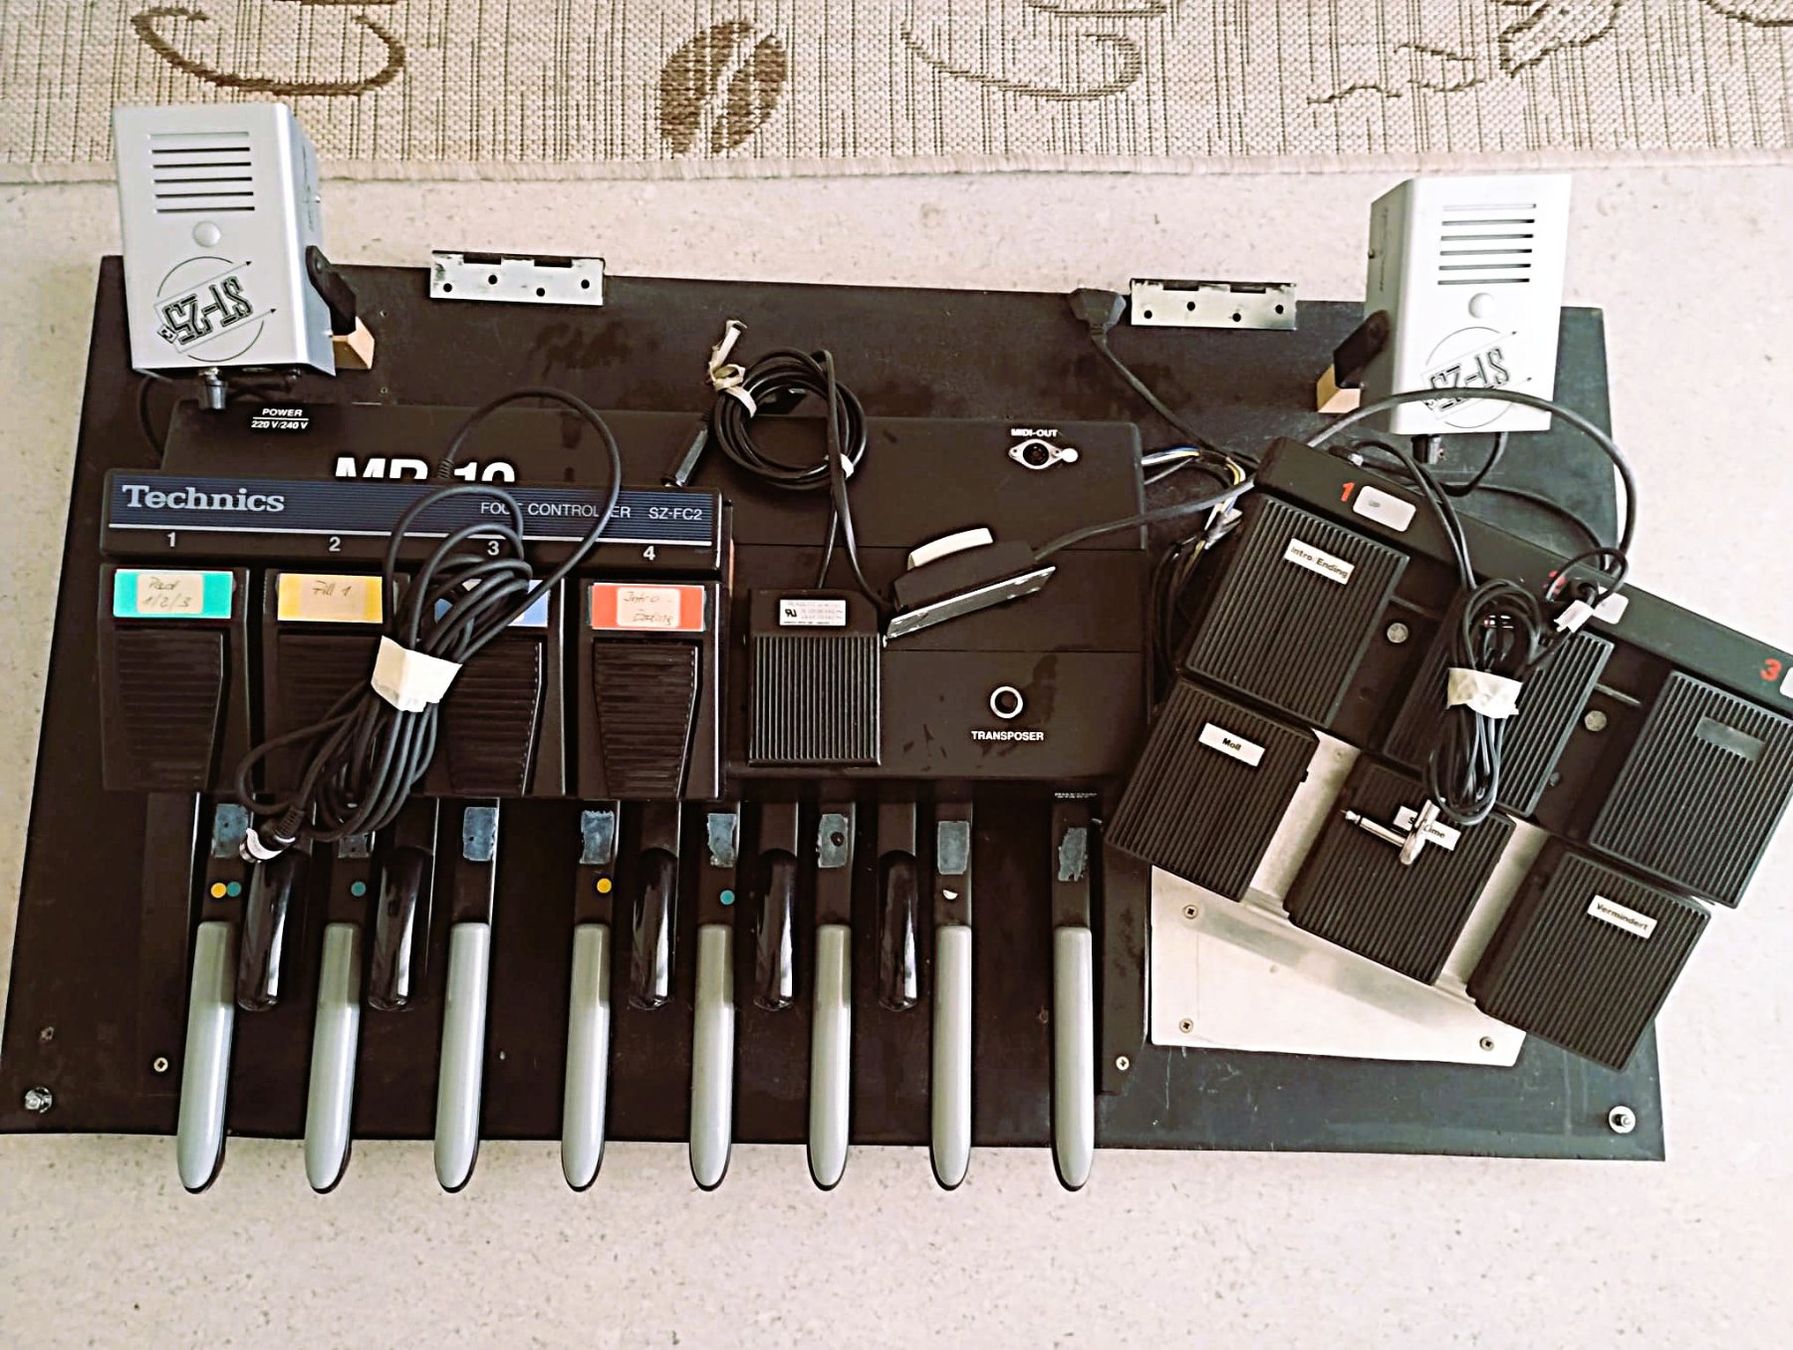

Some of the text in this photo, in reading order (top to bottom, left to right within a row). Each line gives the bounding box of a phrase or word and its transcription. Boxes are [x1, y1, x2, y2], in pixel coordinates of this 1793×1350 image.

[262, 408, 303, 417] POWER
[251, 420, 270, 429] 220
[300, 421, 309, 430] V
[1010, 428, 1058, 438] MIDI-OUT
[122, 484, 285, 513] Technics
[1340, 481, 1356, 502] 1
[527, 502, 631, 518] CONTROLER
[648, 506, 703, 521] SZ-FC2
[167, 531, 176, 548] 1
[328, 536, 341, 552] 2
[487, 540, 500, 556] 3
[642, 545, 656, 561] 4
[1315, 556, 1350, 579] Ending
[1760, 657, 1783, 682] 3
[970, 730, 1044, 741] TRANSPOSER
[1221, 737, 1243, 752] Moll
[1595, 901, 1649, 931] Vermindert
